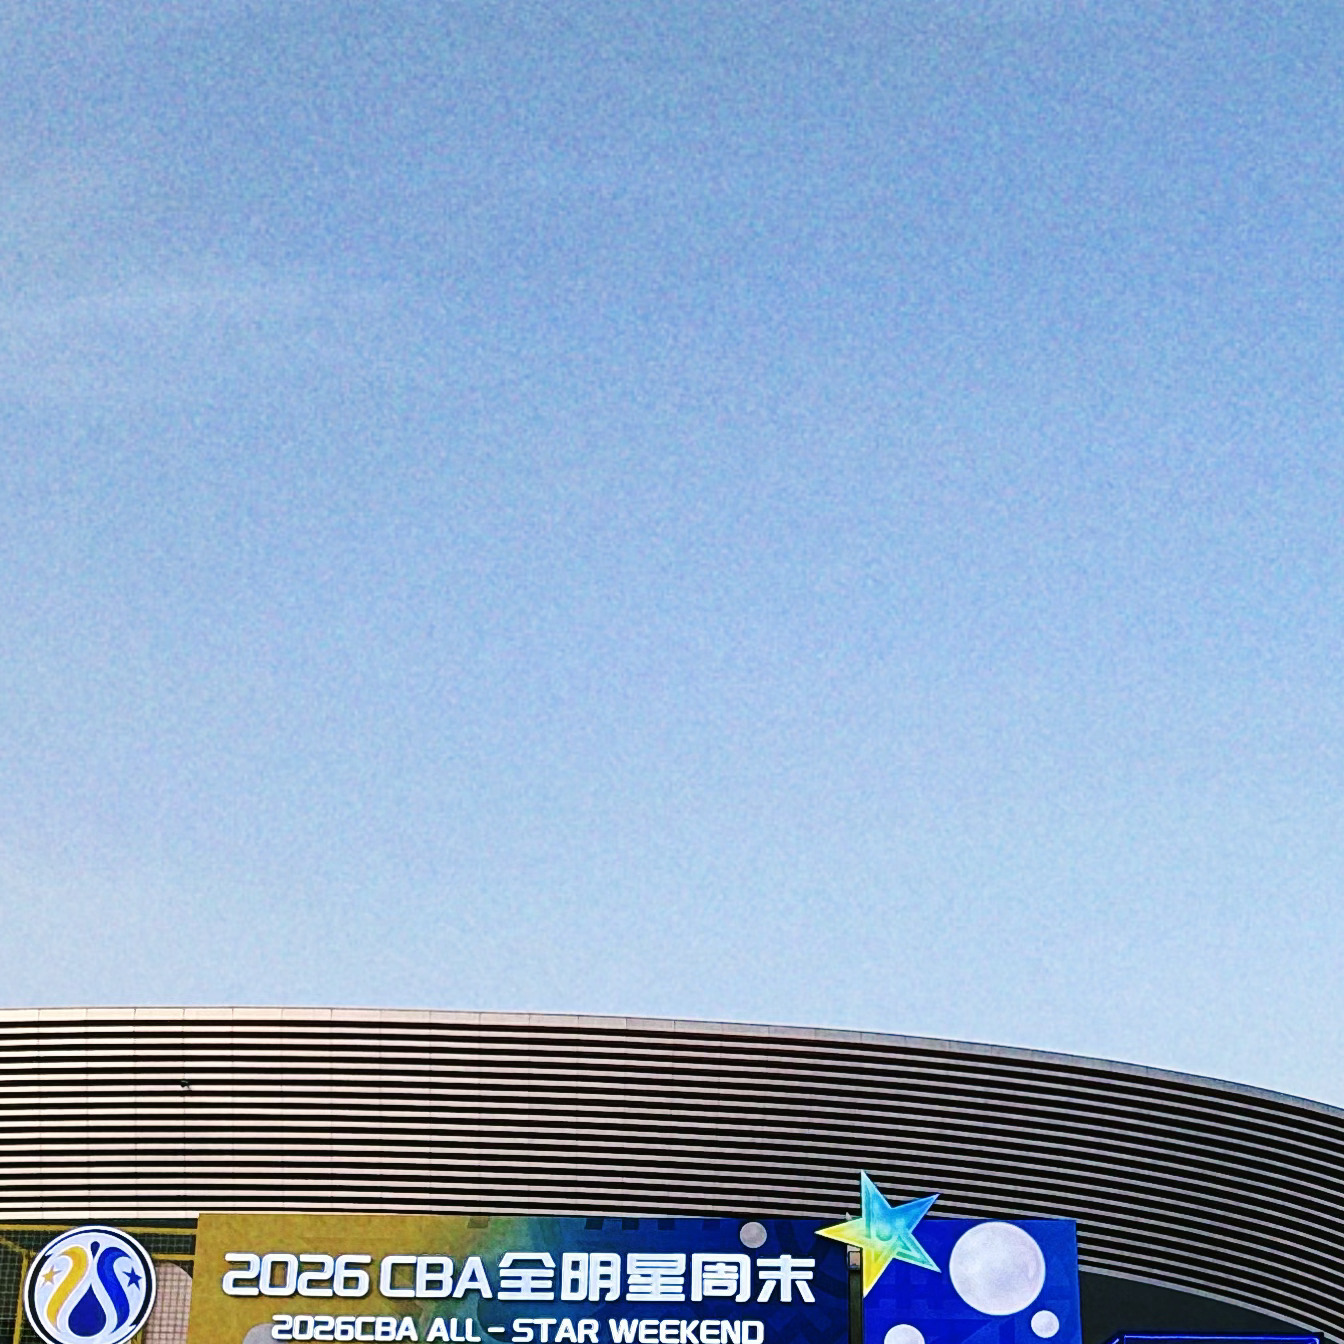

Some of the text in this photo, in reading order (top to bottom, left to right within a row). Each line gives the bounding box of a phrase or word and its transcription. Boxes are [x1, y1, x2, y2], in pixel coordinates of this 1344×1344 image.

[222, 1253, 370, 1298] 2026
[271, 1315, 416, 1342] 2026CBA
[426, 1317, 481, 1343] ALL
[512, 1318, 599, 1344] STAR
